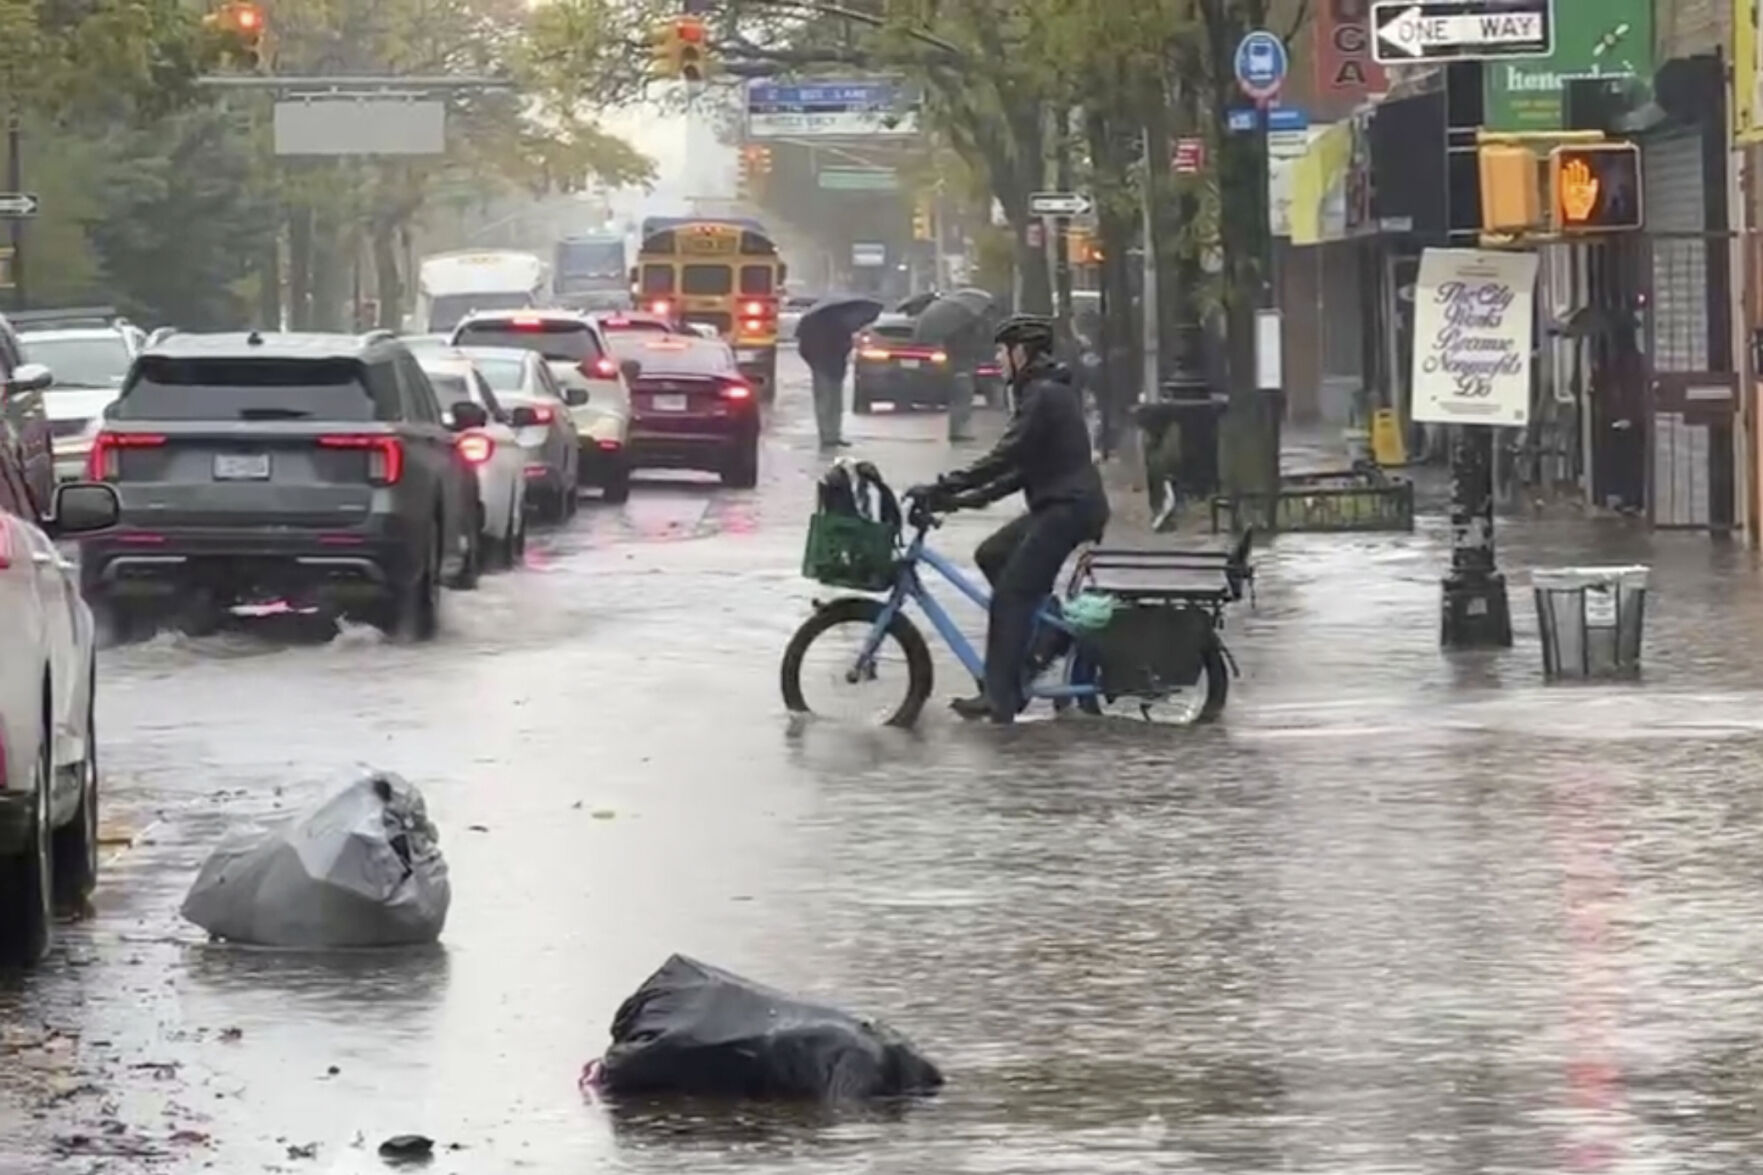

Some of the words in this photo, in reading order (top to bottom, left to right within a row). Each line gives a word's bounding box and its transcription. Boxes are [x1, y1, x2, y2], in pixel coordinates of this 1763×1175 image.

[1398, 19, 1449, 42] ONE
[1480, 15, 1536, 38] WAY
[1434, 281, 1479, 304] The
[1479, 283, 1515, 312] City
[1444, 303, 1502, 328] Works
[1432, 327, 1515, 352] Because
[1422, 352, 1522, 380] Nonprofits
[1453, 374, 1492, 397] Do
